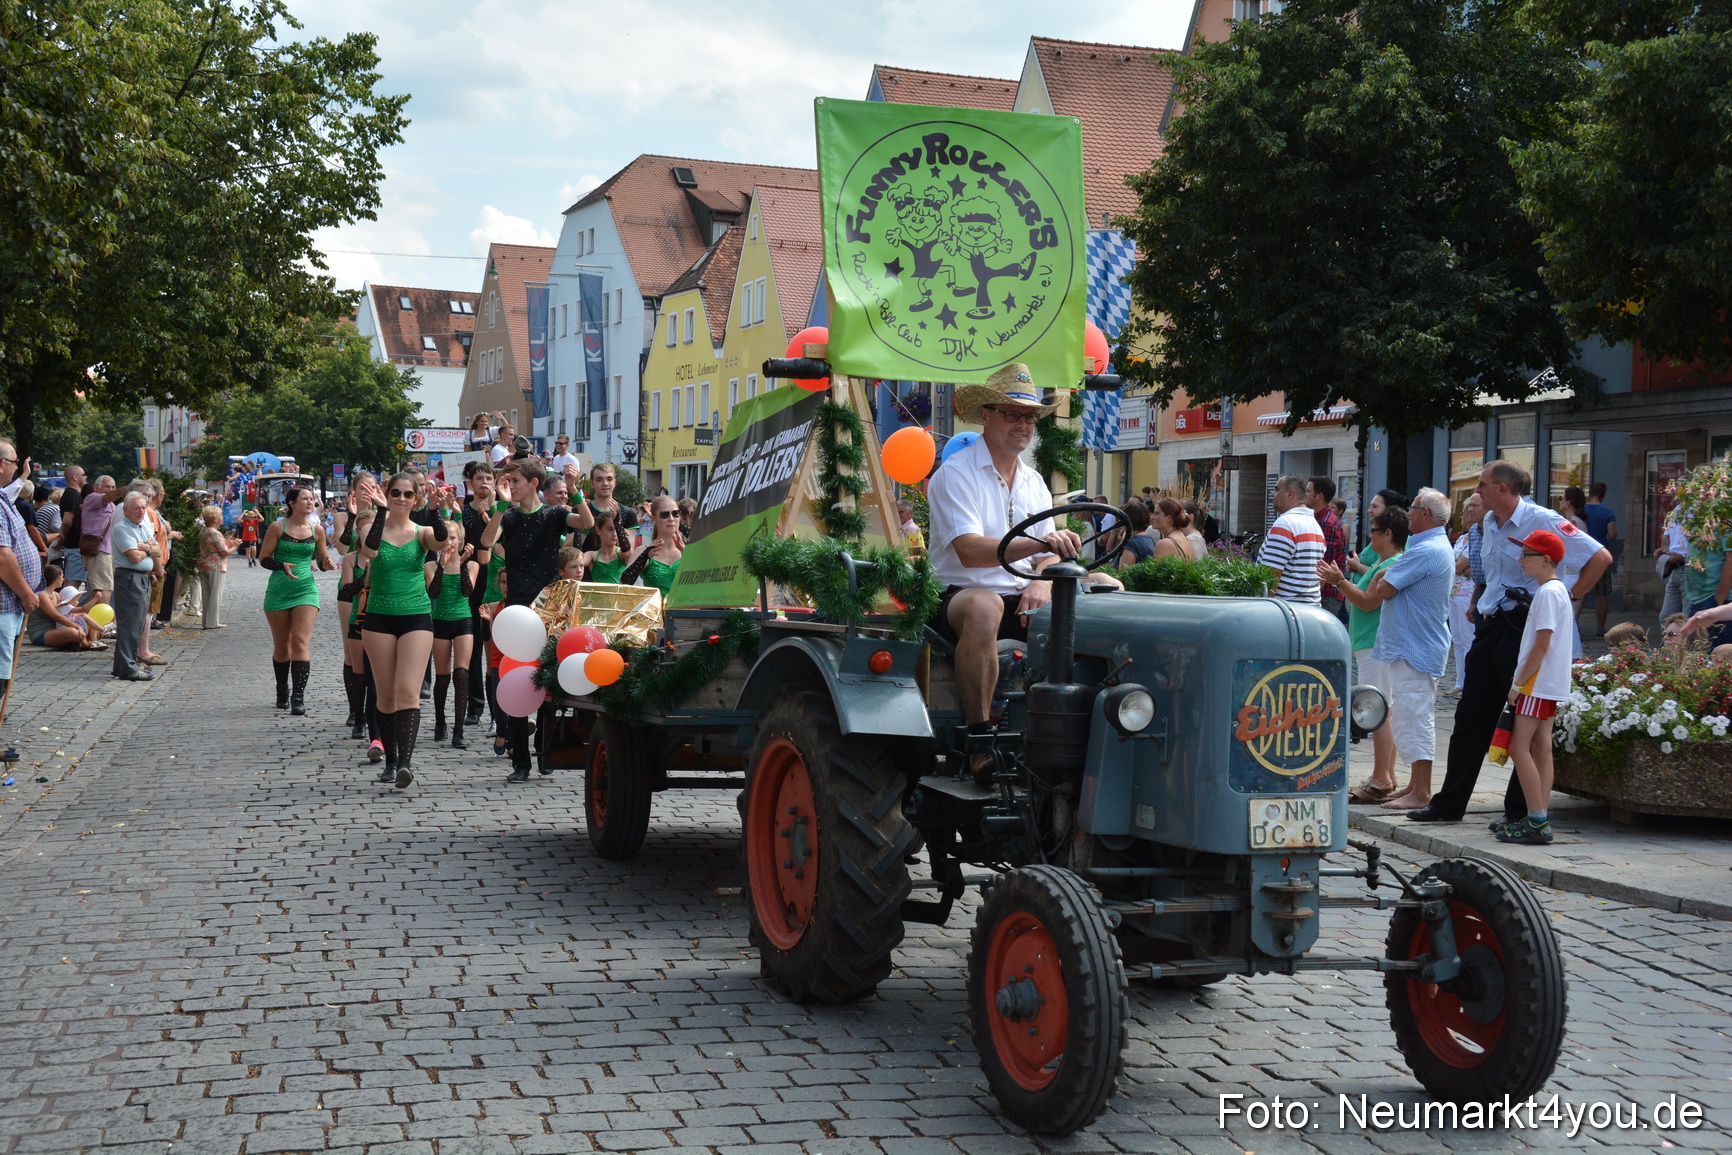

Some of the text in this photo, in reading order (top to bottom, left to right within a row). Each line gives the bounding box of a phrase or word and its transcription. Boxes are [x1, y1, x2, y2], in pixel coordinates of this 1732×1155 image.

[846, 148, 922, 244] FUNNY
[939, 338, 979, 362] DJK
[986, 295, 1046, 349] Neumarkt
[675, 363, 694, 382] HOTEL
[436, 430, 467, 438] HOLZHEIM
[1148, 400, 1156, 446] KINO
[672, 445, 698, 458] Restaurant
[699, 467, 745, 519] FUNNY
[1234, 696, 1344, 742] Eicher
[1259, 683, 1327, 757] DIESEL
[1252, 823, 1330, 846] DC 68
[1285, 801, 1316, 822] NM
